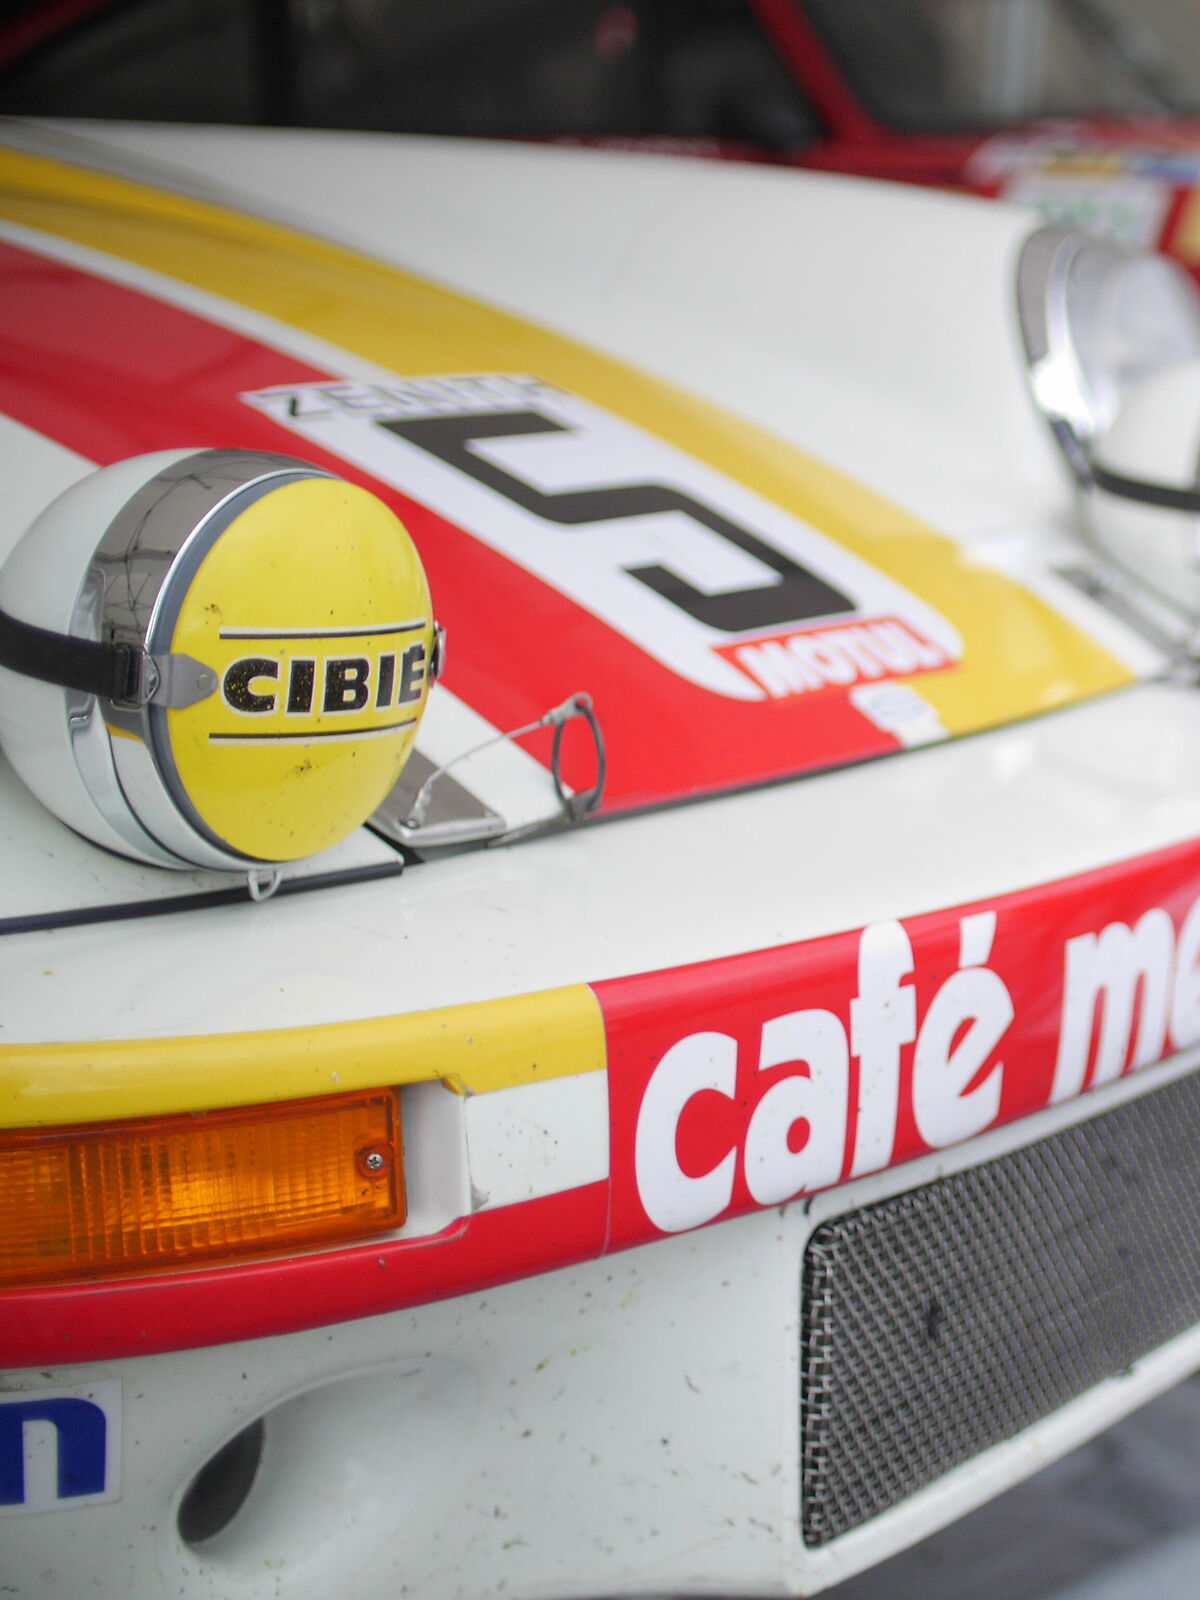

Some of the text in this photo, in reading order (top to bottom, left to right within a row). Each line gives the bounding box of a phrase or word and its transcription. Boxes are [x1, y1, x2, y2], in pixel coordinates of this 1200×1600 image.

[252, 371, 572, 420] ZENITH
[374, 411, 858, 632] 5
[736, 620, 946, 699] MOTUL
[634, 911, 1014, 1232] café
